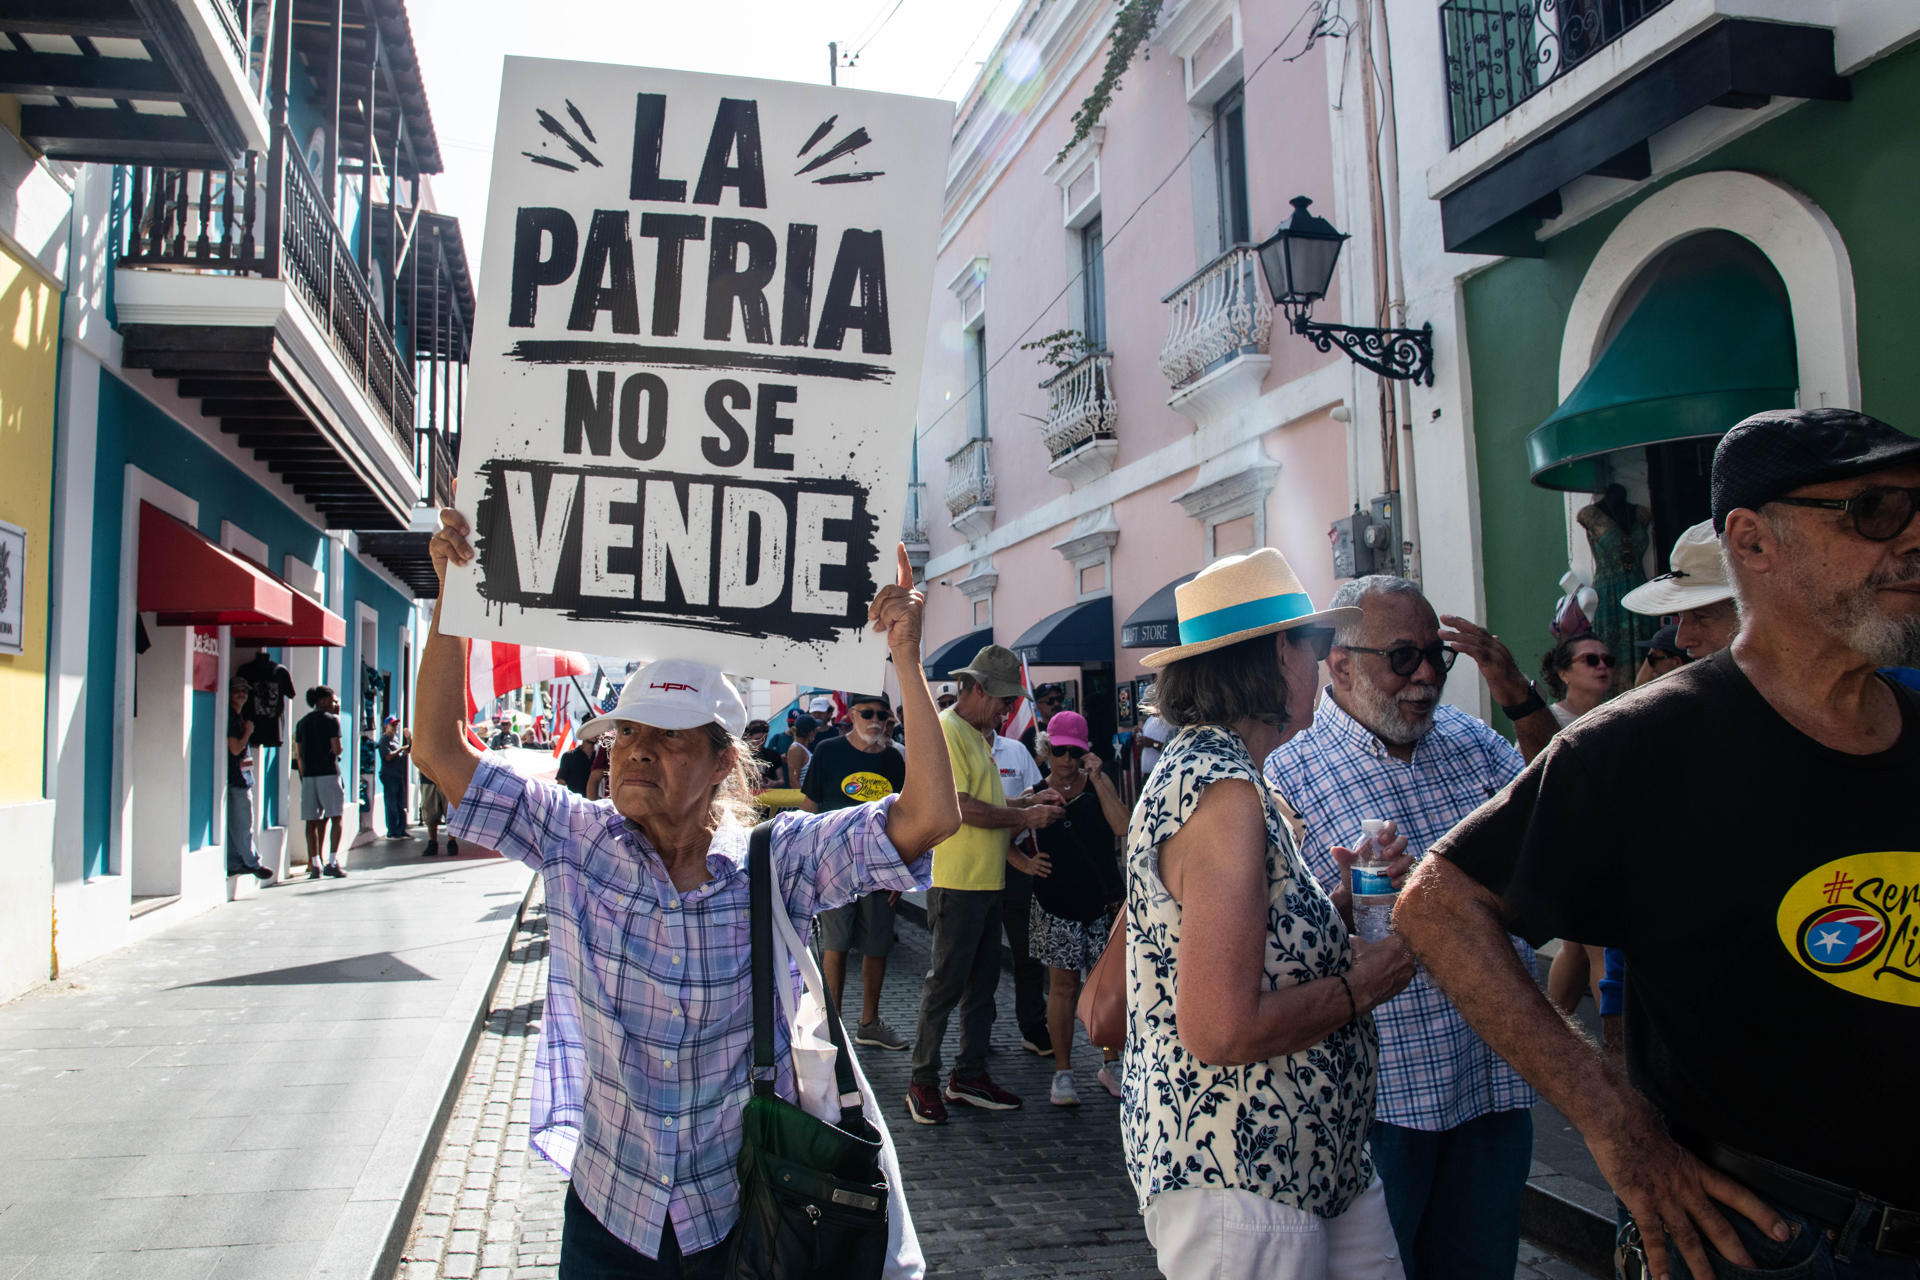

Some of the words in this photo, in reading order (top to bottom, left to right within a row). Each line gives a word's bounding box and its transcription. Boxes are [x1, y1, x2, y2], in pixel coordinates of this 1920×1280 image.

[629, 92, 767, 208] LA
[508, 206, 892, 354] PATRIA
[563, 369, 669, 461] NO
[700, 378, 798, 470] SE
[504, 470, 855, 616] VENDE
[1142, 624, 1168, 641] STORE
